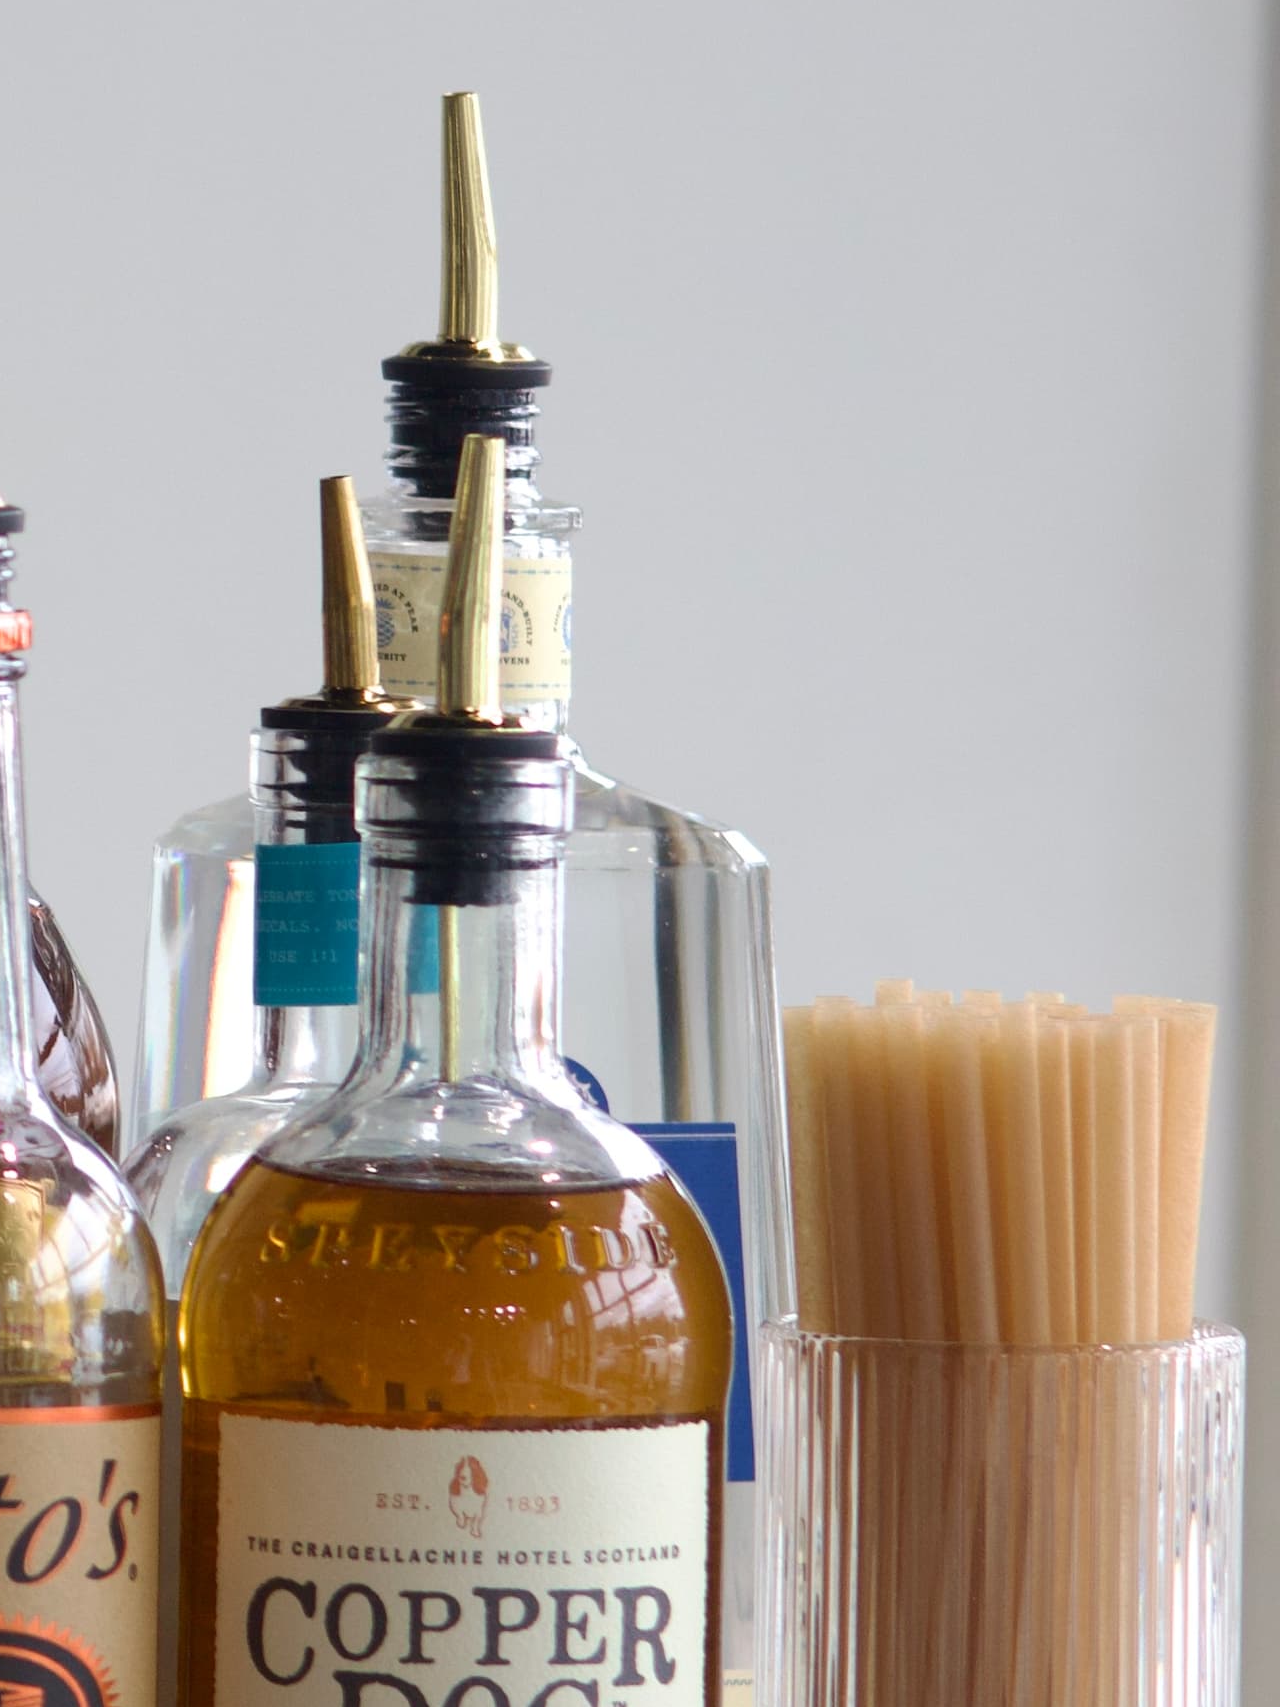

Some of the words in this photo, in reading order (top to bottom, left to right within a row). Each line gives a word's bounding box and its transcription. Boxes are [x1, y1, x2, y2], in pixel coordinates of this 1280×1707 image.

[392, 587, 406, 600] AT
[405, 600, 419, 635] PEAK
[377, 652, 408, 662] URITY
[311, 948, 337, 964] 1:1
[259, 1220, 677, 1276] SPEYSIDE
[375, 1492, 432, 1512] EST.
[504, 1494, 562, 1515] 1893
[247, 1536, 282, 1556] THE
[291, 1539, 484, 1566] CRAIGELLACHIE
[497, 1549, 571, 1566] HOTEL
[583, 1544, 680, 1564] SCOTLAND
[246, 1576, 677, 1687] COPPER
